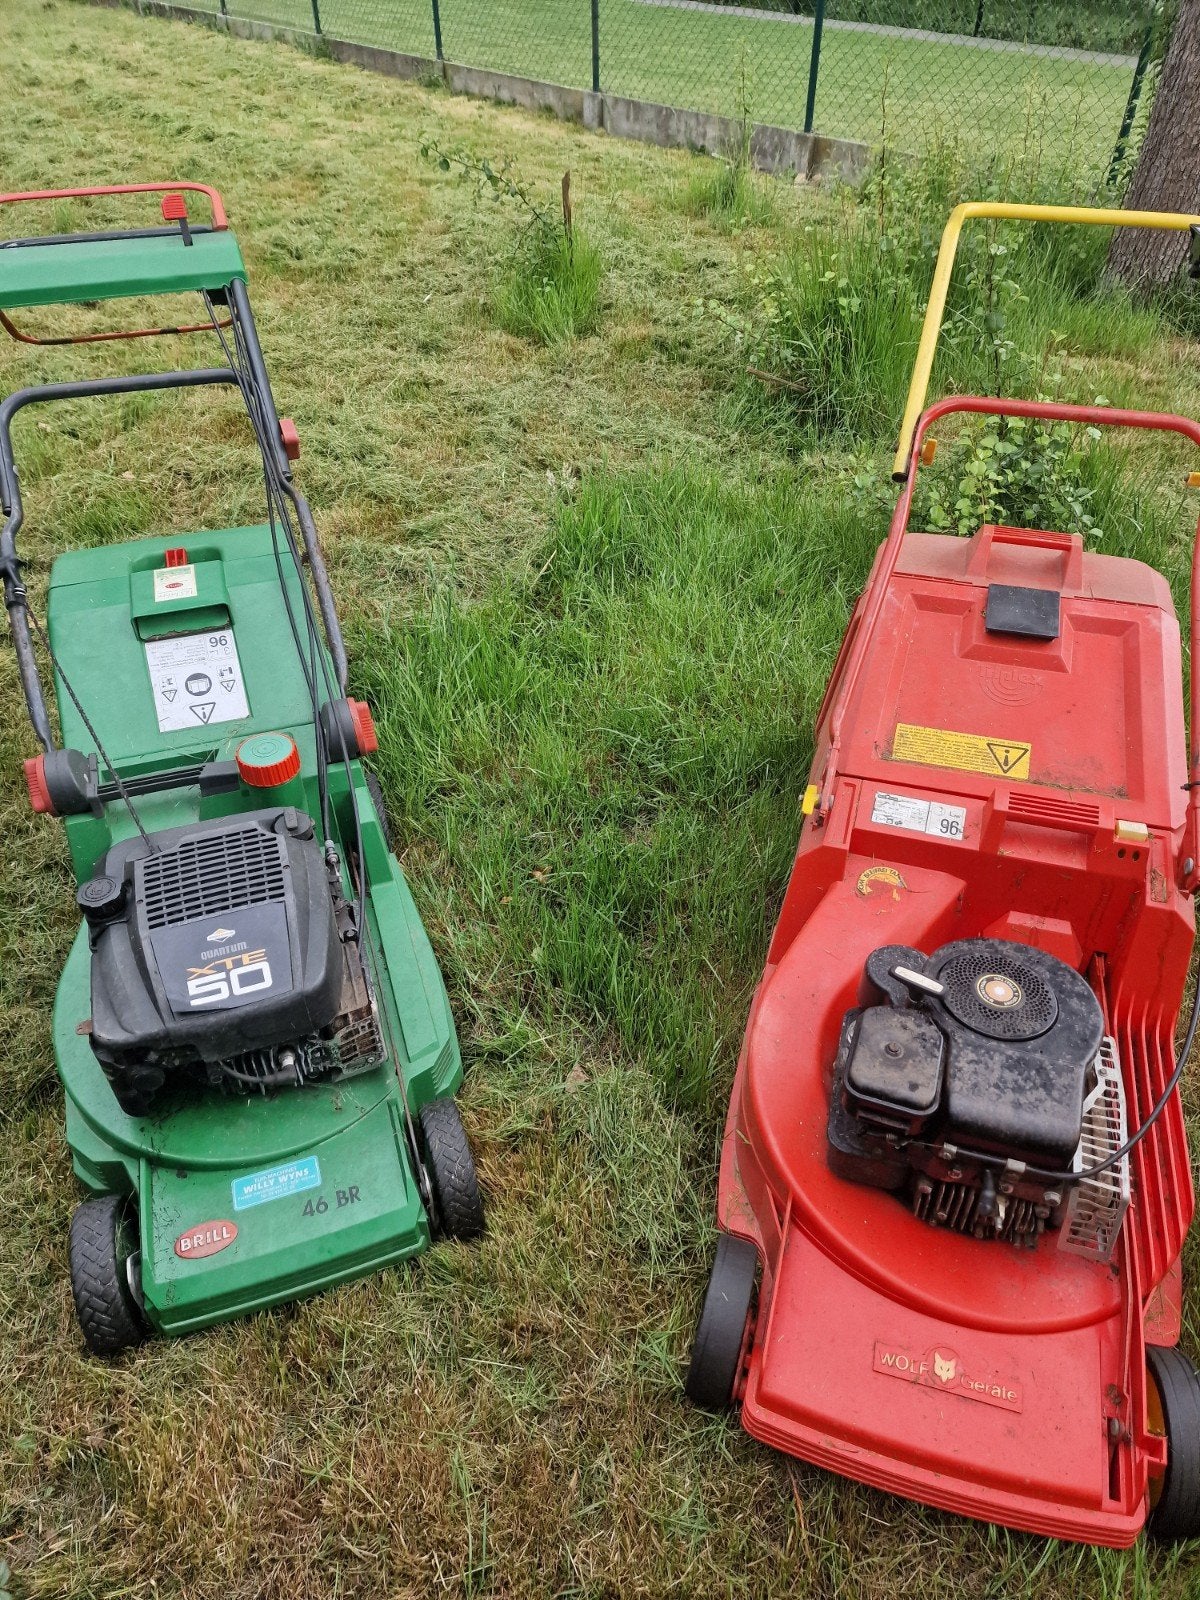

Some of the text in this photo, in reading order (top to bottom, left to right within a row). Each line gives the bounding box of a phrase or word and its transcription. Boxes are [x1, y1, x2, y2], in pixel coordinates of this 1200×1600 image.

[209, 635, 228, 647] 96
[940, 818, 959, 836] 96
[201, 941, 247, 960] QUANTUM
[186, 948, 267, 980] XTE
[187, 961, 272, 1006] 50
[243, 1178, 275, 1194] WILLY
[278, 1168, 309, 1184] WYNS
[302, 1196, 328, 1216] 46
[335, 1185, 361, 1208] BR
[179, 1226, 231, 1252] BRILL
[880, 1352, 929, 1375] WOLF
